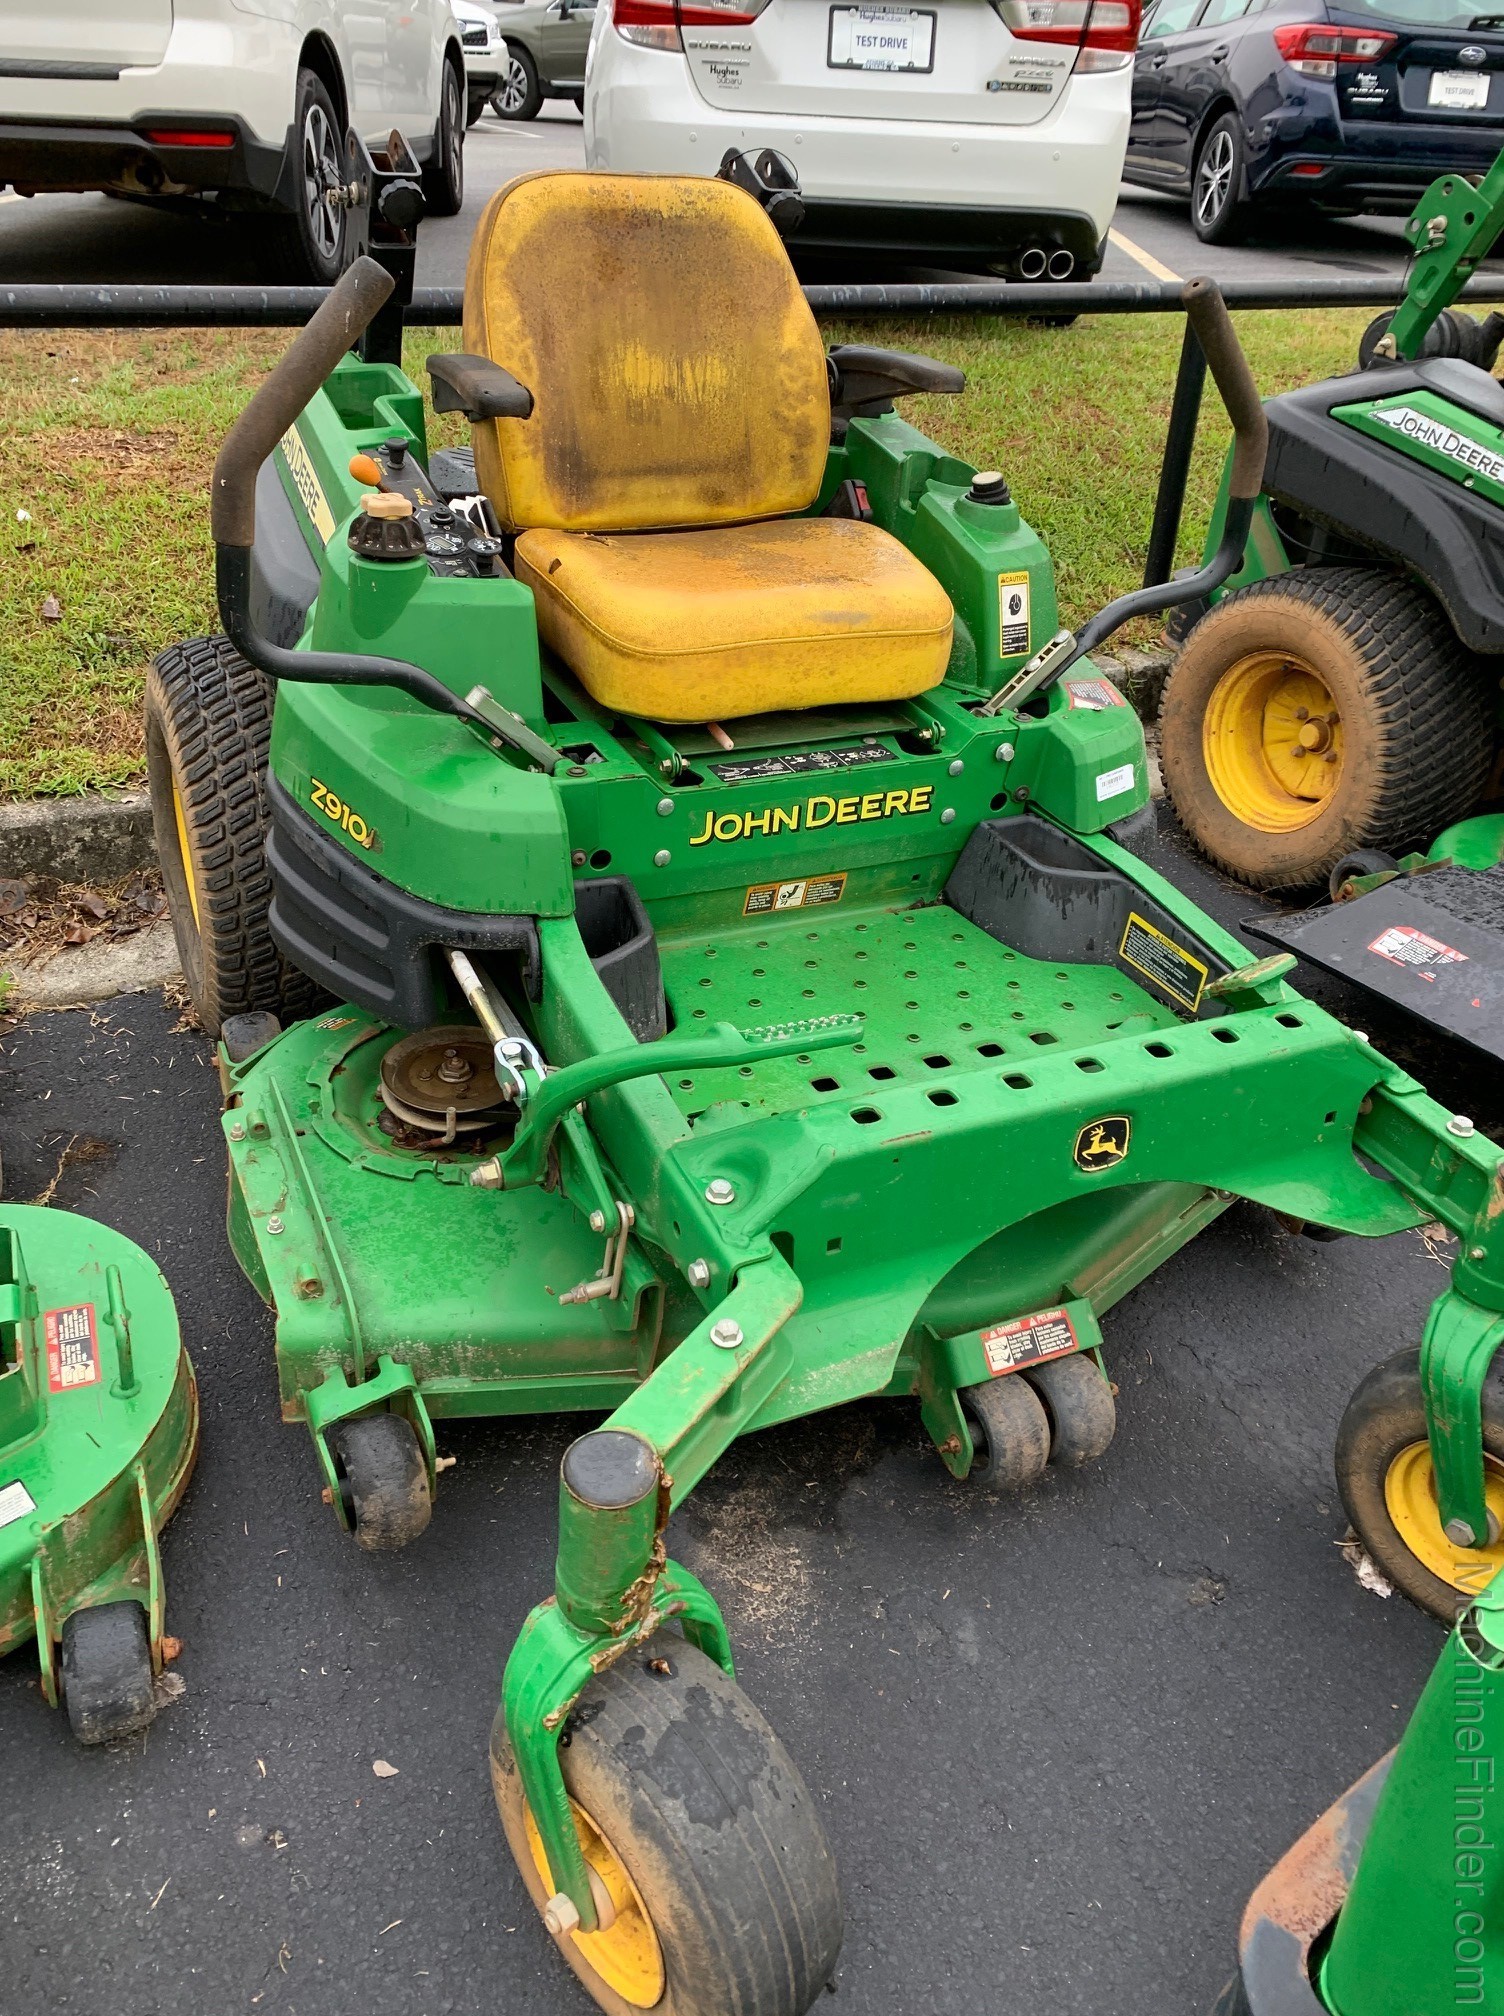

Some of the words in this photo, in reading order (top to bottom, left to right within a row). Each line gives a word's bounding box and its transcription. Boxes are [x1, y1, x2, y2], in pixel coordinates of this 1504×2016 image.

[688, 39, 752, 51] SUBARU
[856, 34, 879, 47] TEST
[880, 37, 908, 49] DRIVE
[710, 64, 739, 77] Hughes
[1392, 411, 1444, 446] JOHN
[1443, 433, 1504, 477] DEERE
[293, 445, 320, 519] DEERE
[1005, 574, 1028, 583] CAUTION
[689, 804, 801, 846] JOHN
[805, 785, 934, 830] DEERE
[996, 1321, 1022, 1335] DANGER
